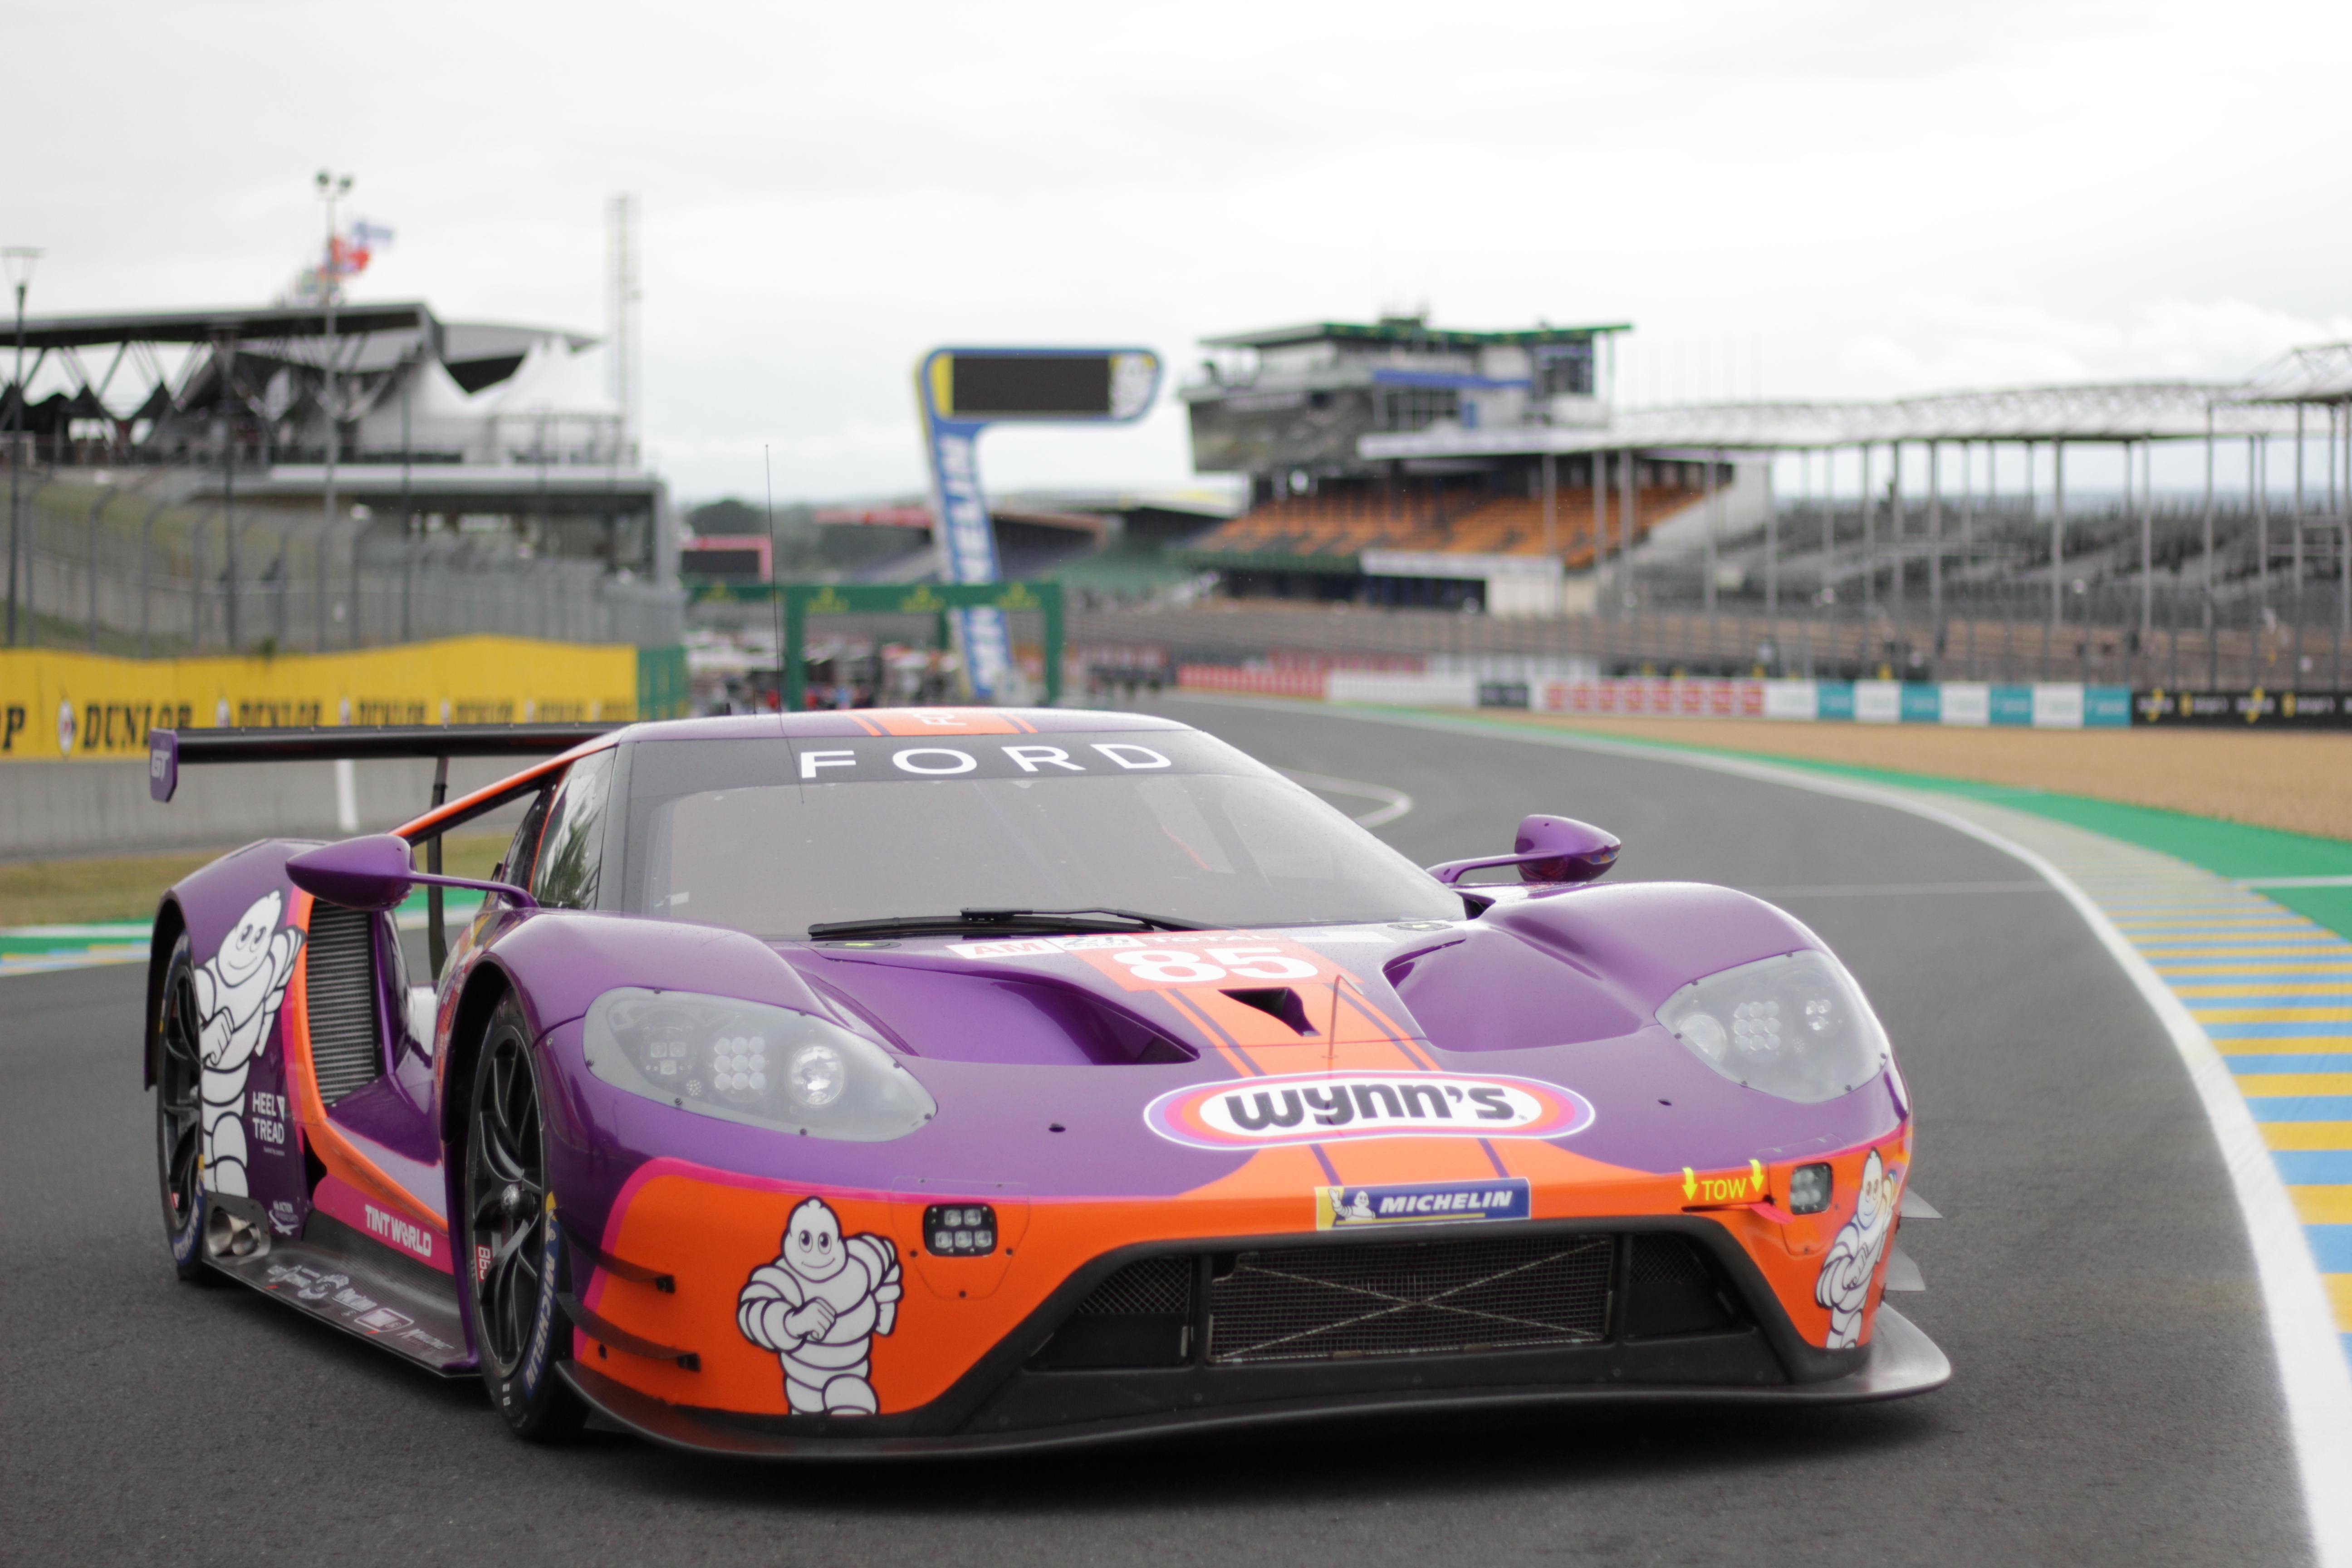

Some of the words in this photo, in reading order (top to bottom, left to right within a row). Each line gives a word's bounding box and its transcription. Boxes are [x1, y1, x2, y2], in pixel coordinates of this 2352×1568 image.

[800, 744, 1172, 779] FORD
[974, 942, 1046, 955] AM
[1112, 947, 1318, 982] 85
[252, 1091, 277, 1117] HEEL
[252, 1117, 285, 1145] TREAD
[1379, 1191, 1513, 1214] MICHELIN
[1701, 1178, 1747, 1201] TOW
[365, 1204, 390, 1237] TINT
[391, 1216, 432, 1258] WORLD
[525, 1251, 556, 1390] MICHELIN
